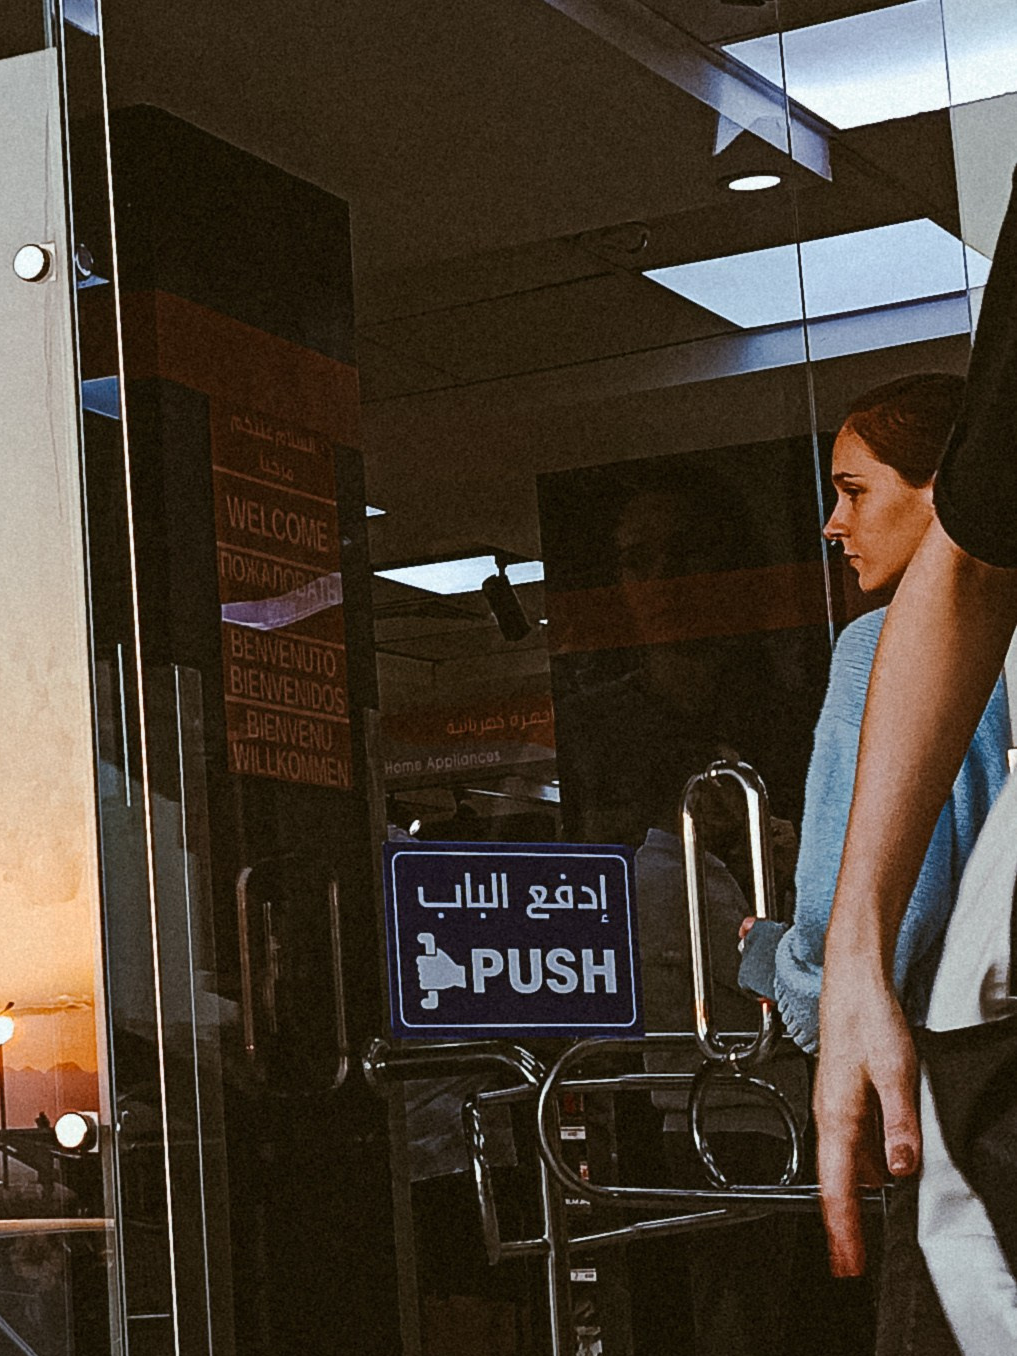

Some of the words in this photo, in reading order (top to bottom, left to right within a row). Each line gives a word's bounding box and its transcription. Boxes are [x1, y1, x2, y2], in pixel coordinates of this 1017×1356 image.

[226, 494, 329, 553] WELCOME
[220, 550, 339, 603] ПОЖАЛОВАТЬ
[230, 628, 337, 677] BENVENUTO
[230, 664, 346, 715] BIENVENIDOS
[246, 709, 333, 751] BIENVENU
[232, 740, 349, 788] WILLKOMMEN
[384, 759, 422, 775] Home
[426, 750, 502, 772] Appliances
[417, 872, 509, 919] الباب
[526, 873, 610, 923] إدفع
[471, 948, 618, 994] PUSH
